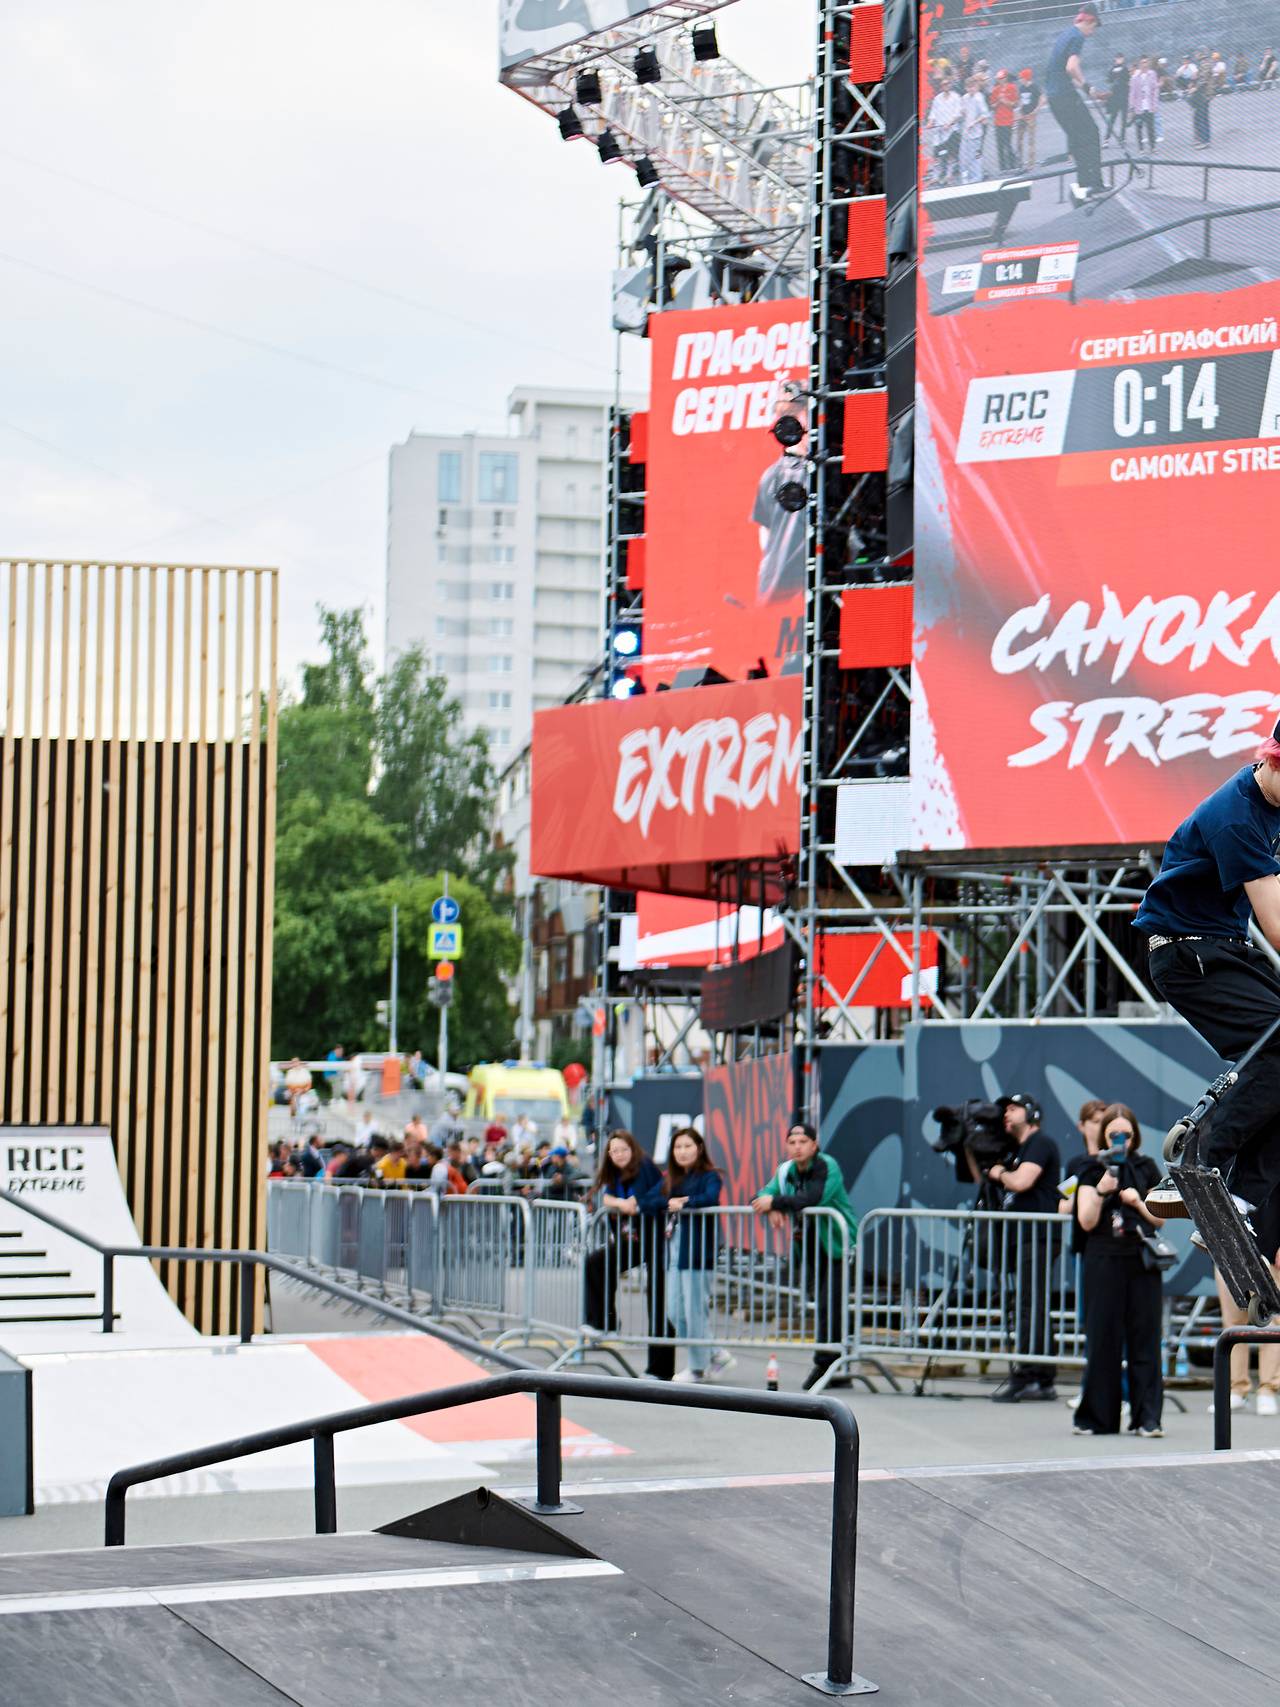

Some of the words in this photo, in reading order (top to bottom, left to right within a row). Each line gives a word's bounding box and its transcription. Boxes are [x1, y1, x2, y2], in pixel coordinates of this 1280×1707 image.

[672, 320, 811, 380] ГРАФСК
[1080, 329, 1157, 361] СЕРГЕЙ
[1159, 317, 1279, 353] ГРАФСКИЙ
[982, 389, 1049, 424] RCC
[1113, 362, 1220, 437] 0:14
[979, 426, 1045, 448] EXTREME
[1110, 450, 1219, 482] САМОКАТ
[613, 712, 803, 839] EXTREM
[8, 1146, 84, 1171] RCC
[8, 1177, 86, 1194] EXTREME
